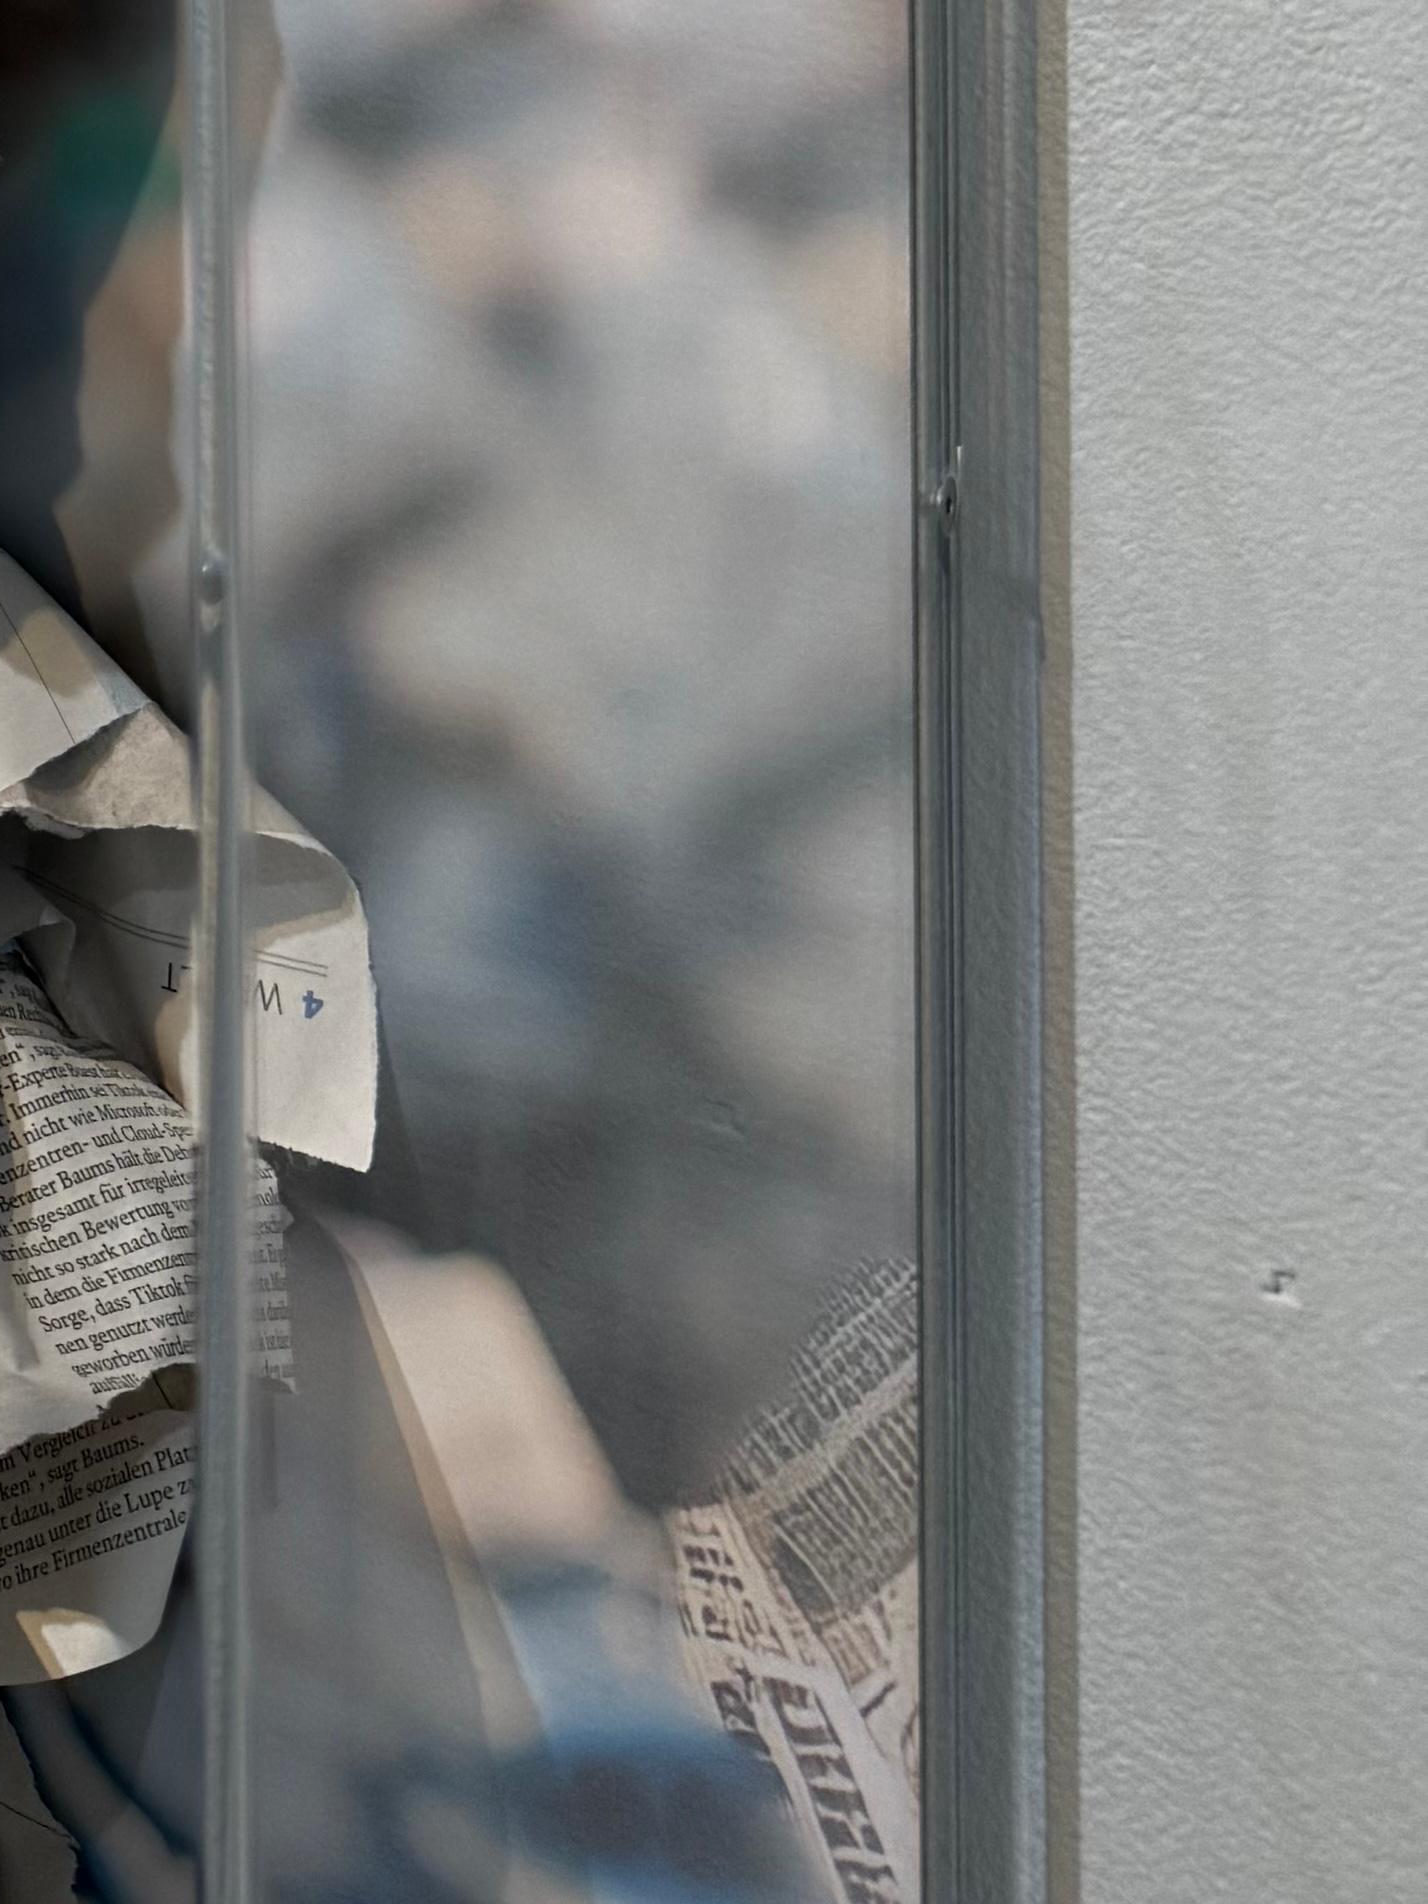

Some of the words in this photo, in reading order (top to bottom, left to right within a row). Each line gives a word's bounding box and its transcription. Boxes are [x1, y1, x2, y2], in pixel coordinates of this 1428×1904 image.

[55, 1159, 115, 1190] Baums
[12, 1193, 98, 1234] insgesamt
[79, 1201, 174, 1246] Bewertung
[37, 1309, 96, 1332] Sorge,
[131, 1276, 185, 1305] Tiktok
[87, 1318, 152, 1351] genutzt
[80, 1434, 144, 1468] Baums.
[86, 1460, 154, 1496] sozialen
[123, 1485, 174, 1513] Lupe
[52, 1506, 188, 1570] Firmenzentrale
